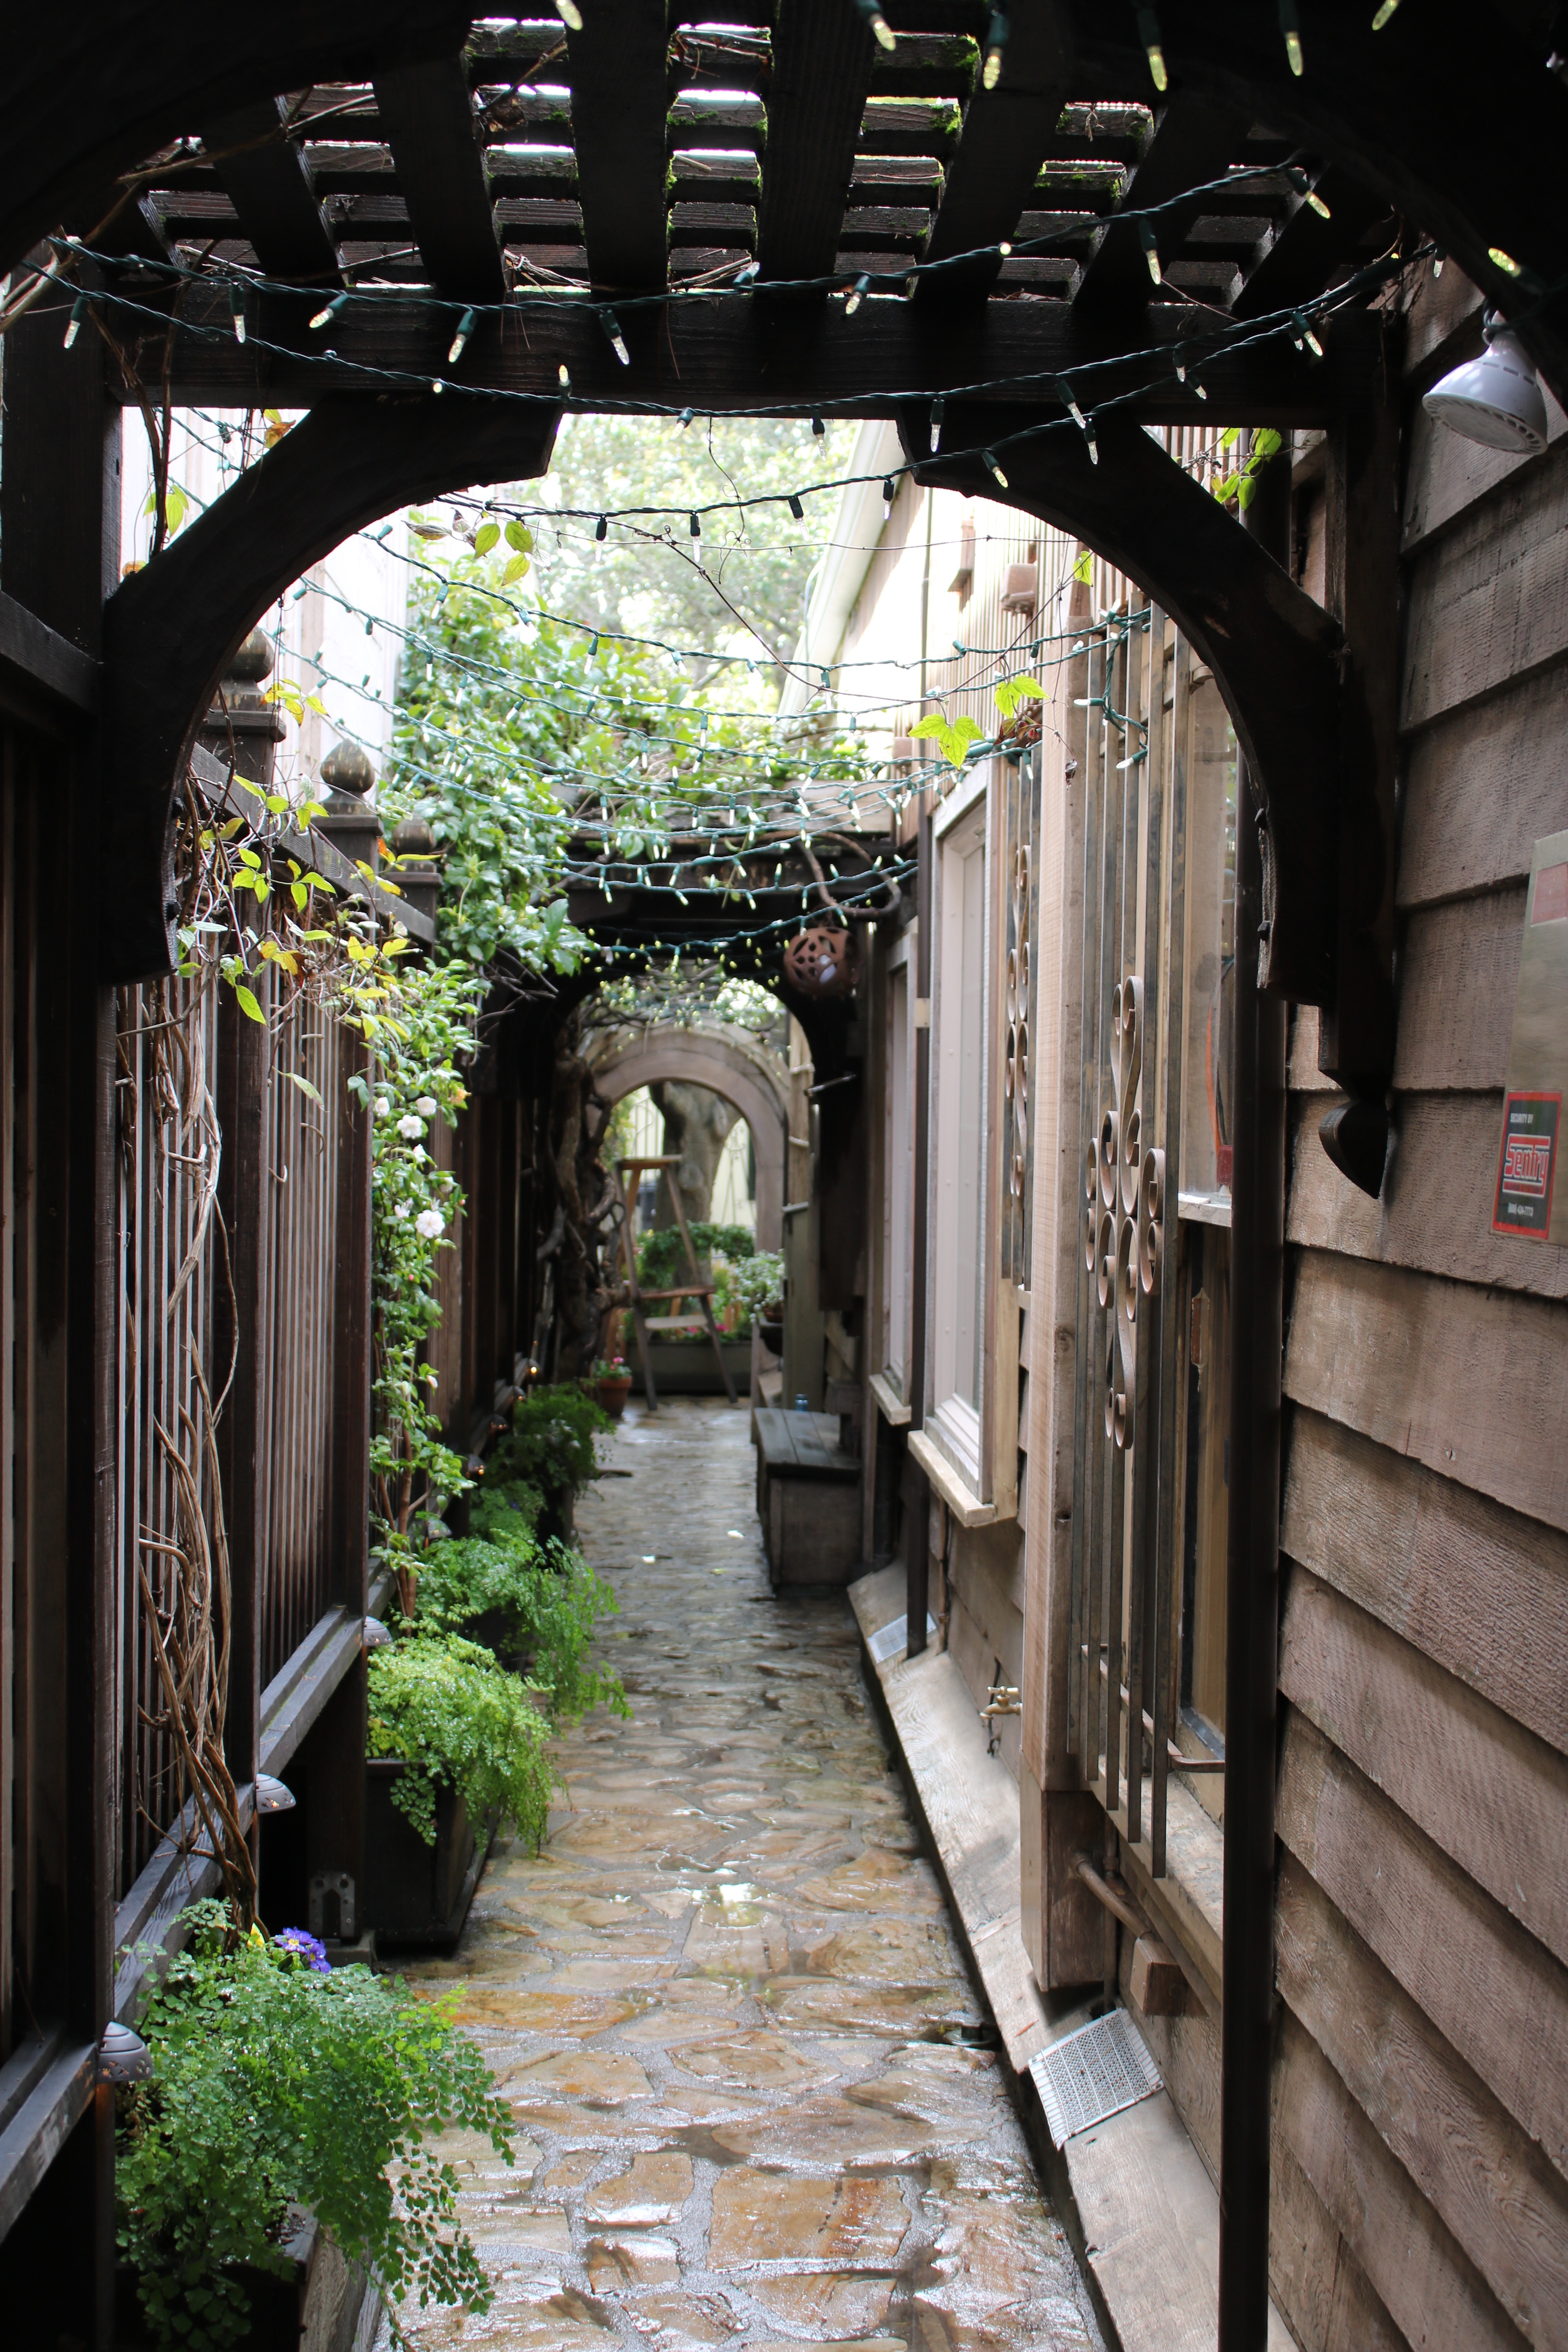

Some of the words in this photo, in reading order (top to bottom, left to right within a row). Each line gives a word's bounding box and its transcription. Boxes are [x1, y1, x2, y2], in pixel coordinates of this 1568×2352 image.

[1510, 1113, 1527, 1123] SECURITY
[1527, 1114, 1534, 1123] BY
[1504, 1133, 1550, 1188] Sentry
